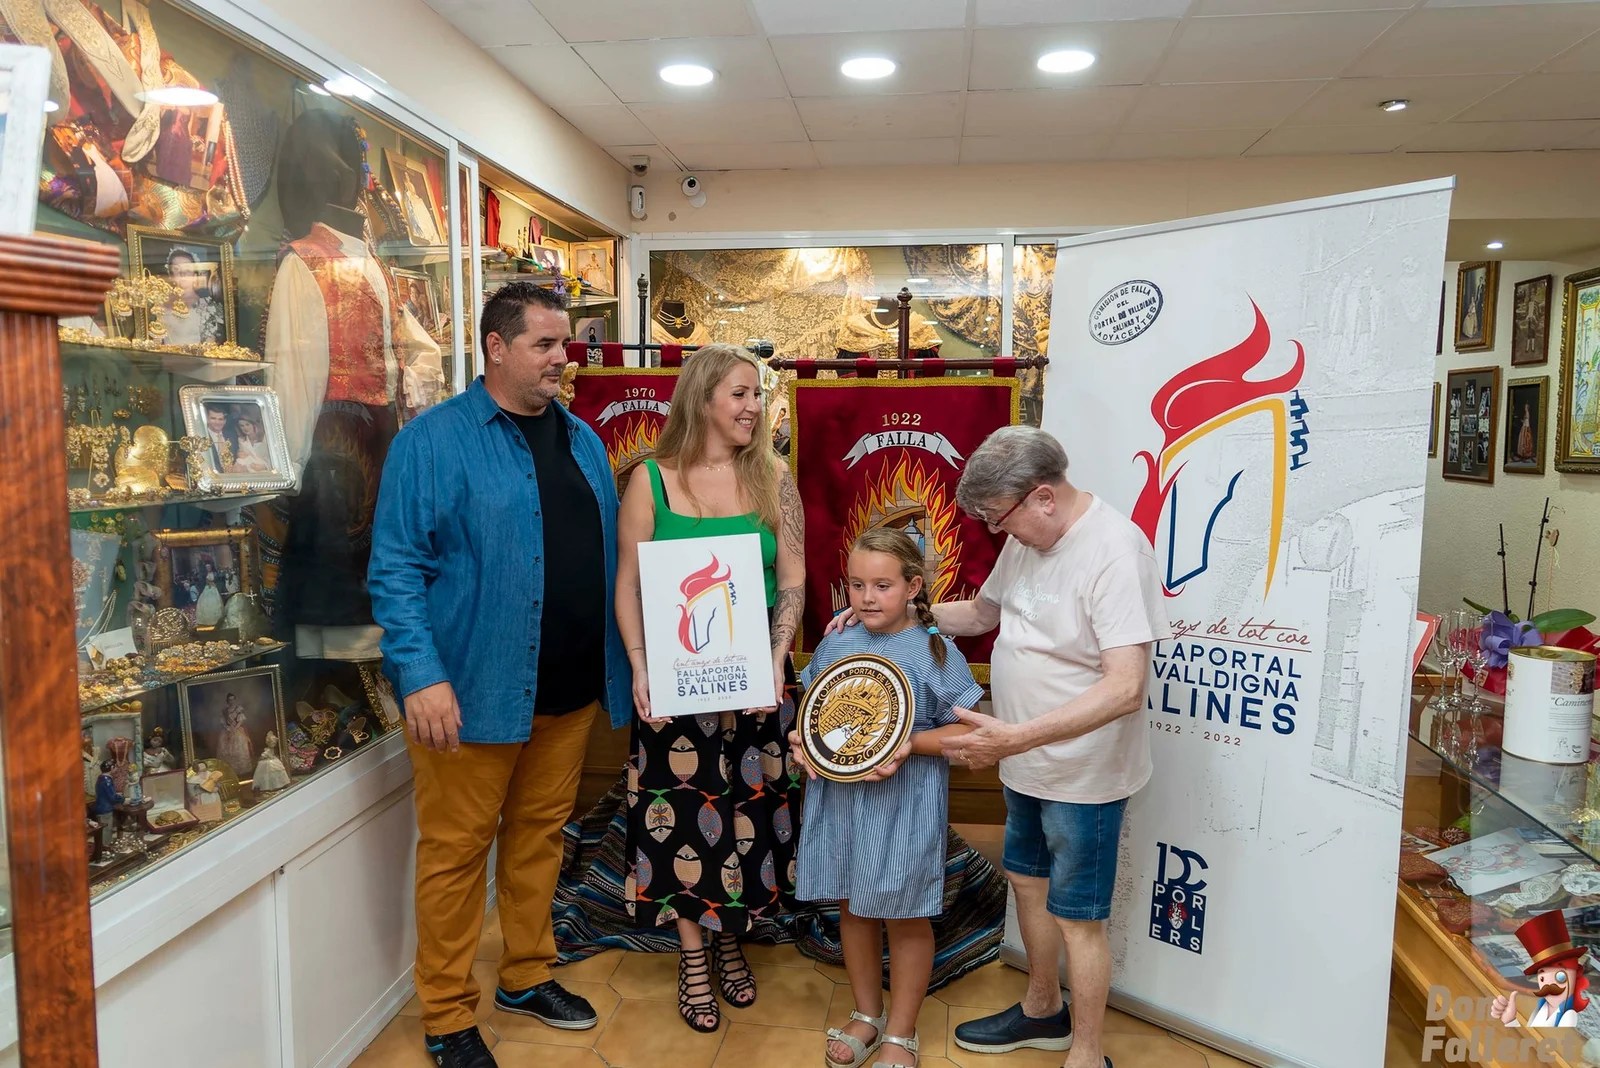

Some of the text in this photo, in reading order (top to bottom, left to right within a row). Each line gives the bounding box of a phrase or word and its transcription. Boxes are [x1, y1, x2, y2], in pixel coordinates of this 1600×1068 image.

[1093, 285, 1151, 320] COMISION DE FALLA
[1116, 299, 1129, 309] DEL
[1094, 316, 1116, 330] PORTAL
[1112, 318, 1135, 333] SALINAS
[624, 387, 656, 398] 1970
[621, 400, 660, 412] FALLA
[881, 412, 922, 427] 1922
[875, 431, 927, 448] FALLA
[1206, 617, 1230, 635] de
[1237, 617, 1275, 641] tot
[1276, 632, 1311, 646] cor
[1155, 640, 1302, 679] LAPORTAL
[677, 672, 748, 686] DE VALLDIGNA
[825, 672, 847, 691] FALLA
[848, 668, 876, 678] PORTAL
[876, 673, 886, 683] DE
[1153, 659, 1300, 702] VALLDIGNA
[677, 679, 748, 697] SALINES
[1148, 683, 1297, 735] LINES
[810, 702, 821, 735] 1922
[873, 722, 896, 753] SALINES
[1149, 720, 1181, 734] 1922
[1203, 731, 1241, 746] 2022
[831, 752, 864, 766] 2022
